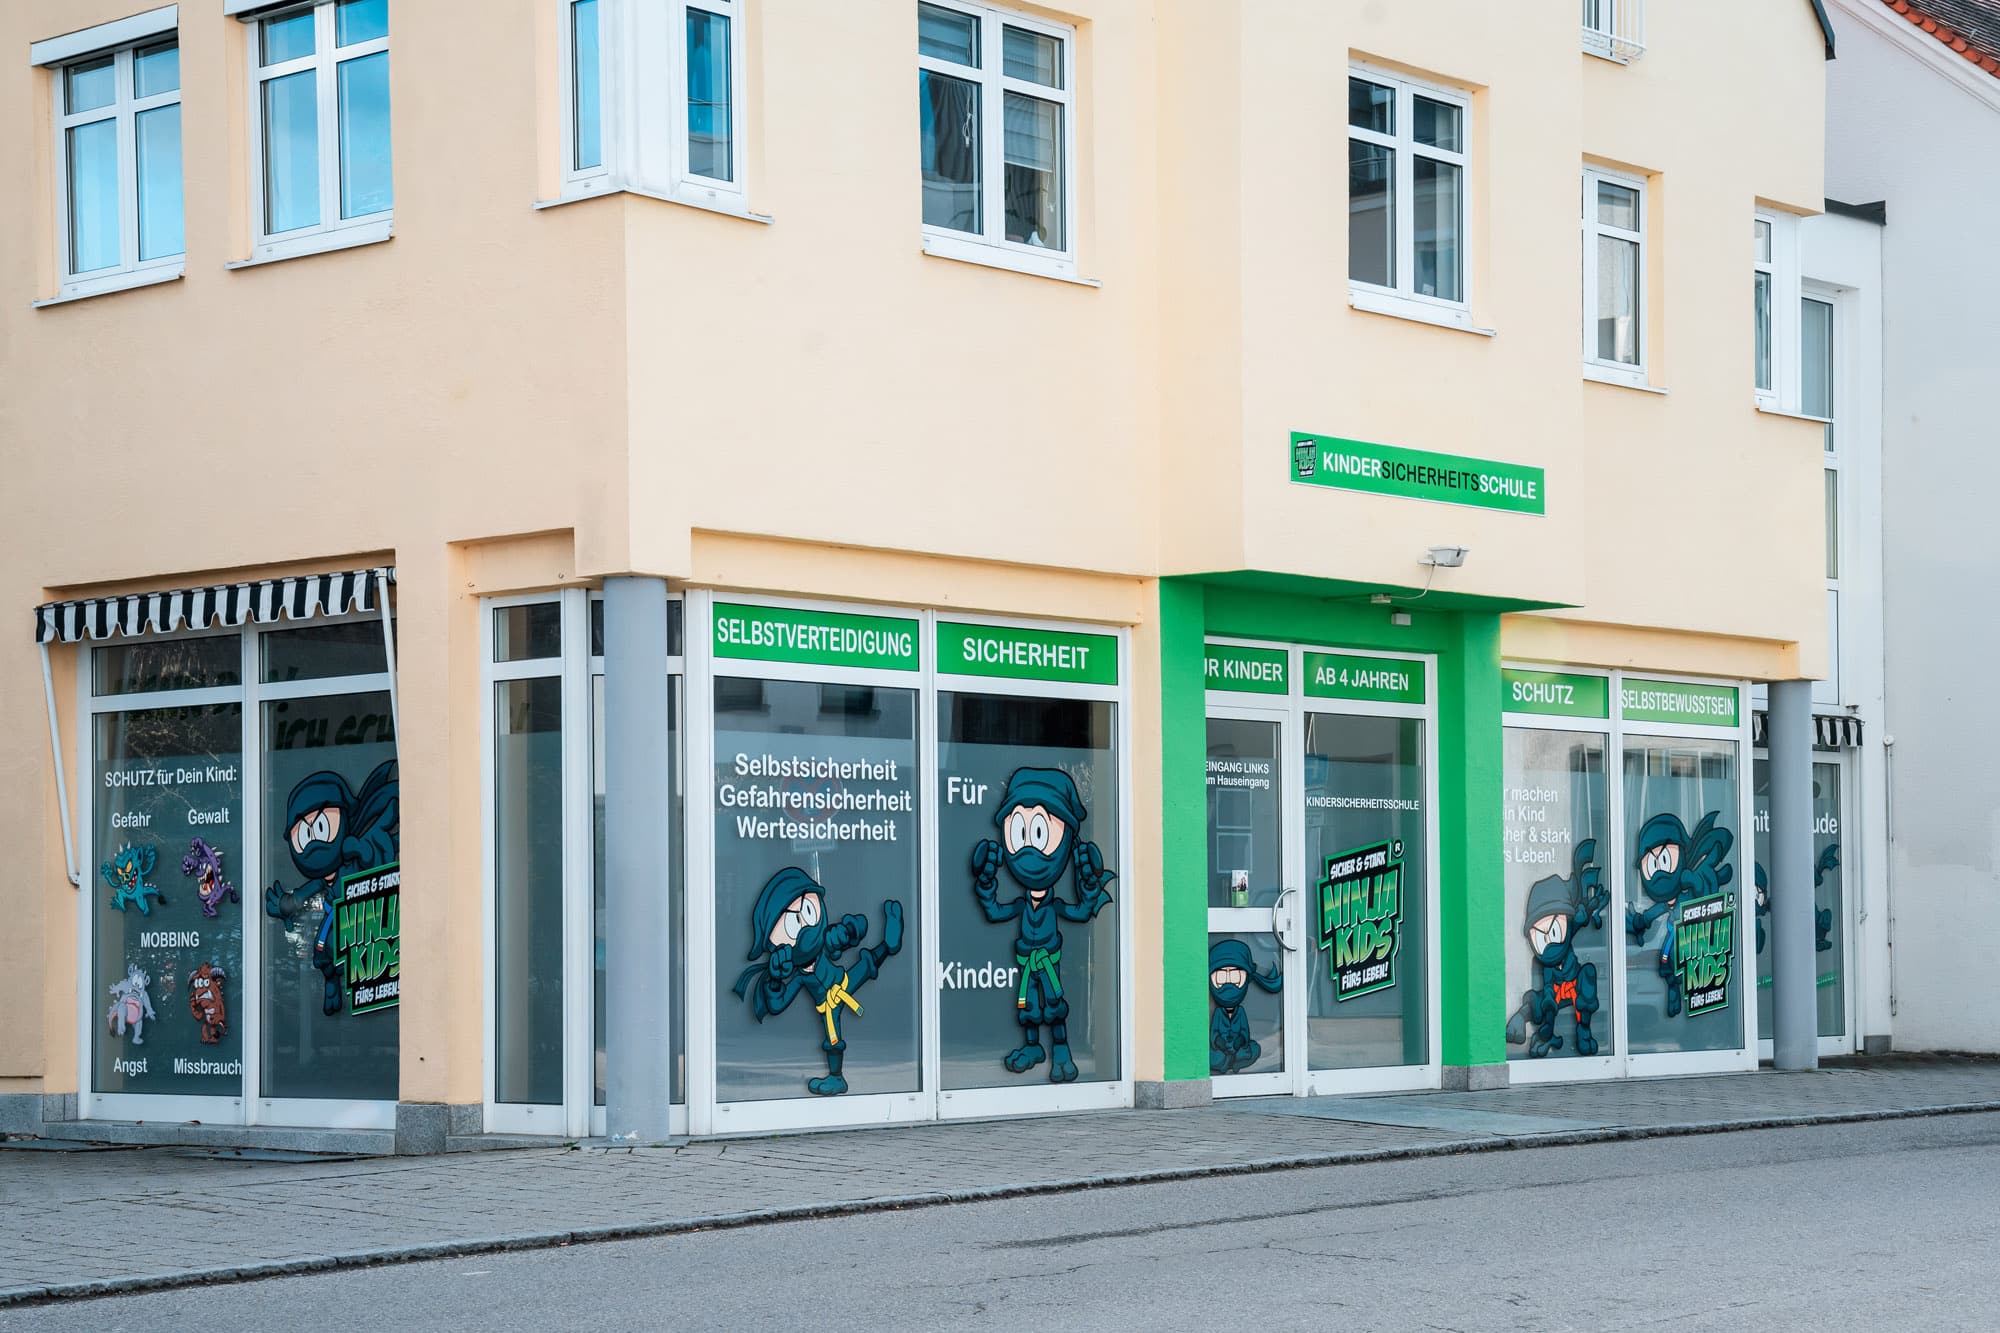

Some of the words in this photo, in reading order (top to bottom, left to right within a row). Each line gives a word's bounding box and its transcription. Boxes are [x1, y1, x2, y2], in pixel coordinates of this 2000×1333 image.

[1322, 451, 1537, 500] KINDERSICHERHEITSSCHULE
[717, 617, 912, 658] SELBSTVERTEIDIGUNG
[962, 637, 1090, 670] SICHERHEIT
[1223, 660, 1283, 682] KINDER
[1315, 667, 1336, 685] AB
[1339, 671, 1348, 687] 4
[1351, 670, 1409, 691] JAHREN
[1512, 681, 1574, 705] SCHUTZ
[1622, 689, 1735, 716] SELBSTBEWUSSTSEIN
[105, 770, 155, 787] SCHUTZ
[157, 769, 174, 785] für
[176, 768, 203, 784] Dein
[206, 765, 237, 782] Kind:
[735, 753, 898, 781] Selbstsicherheit
[1244, 763, 1269, 775] LINKS
[947, 776, 988, 805] Für
[1217, 775, 1270, 790] Hauseingang
[1511, 786, 1558, 802] machen
[719, 784, 912, 812] Gefahrensicherheit
[1306, 796, 1420, 811] KINDERSICHERHEITSSCHULE
[112, 812, 151, 828] Gefahr
[187, 808, 230, 825] Gewalt
[1518, 806, 1545, 822] Kind
[736, 816, 897, 841] Wertesicherheit
[1529, 826, 1538, 842] &
[1541, 828, 1570, 843] stark
[1330, 857, 1355, 880] SICHER
[1356, 857, 1363, 873] &
[1364, 851, 1386, 870] STARK
[1515, 847, 1556, 863] Leben!
[346, 880, 370, 900] SICHER
[1323, 869, 1398, 934] NINJA
[141, 931, 200, 948] MOBBING
[1336, 917, 1393, 968] KIDS
[1679, 915, 1731, 964] NINJA
[937, 961, 1018, 990] Kinder
[1341, 969, 1361, 991] FÜRS
[1362, 961, 1389, 984] LEBEN!
[1686, 954, 1727, 991] KIDS
[355, 985, 374, 1006] FÜRS
[113, 1057, 148, 1077] Angst
[174, 1058, 242, 1076] Missbrauch
